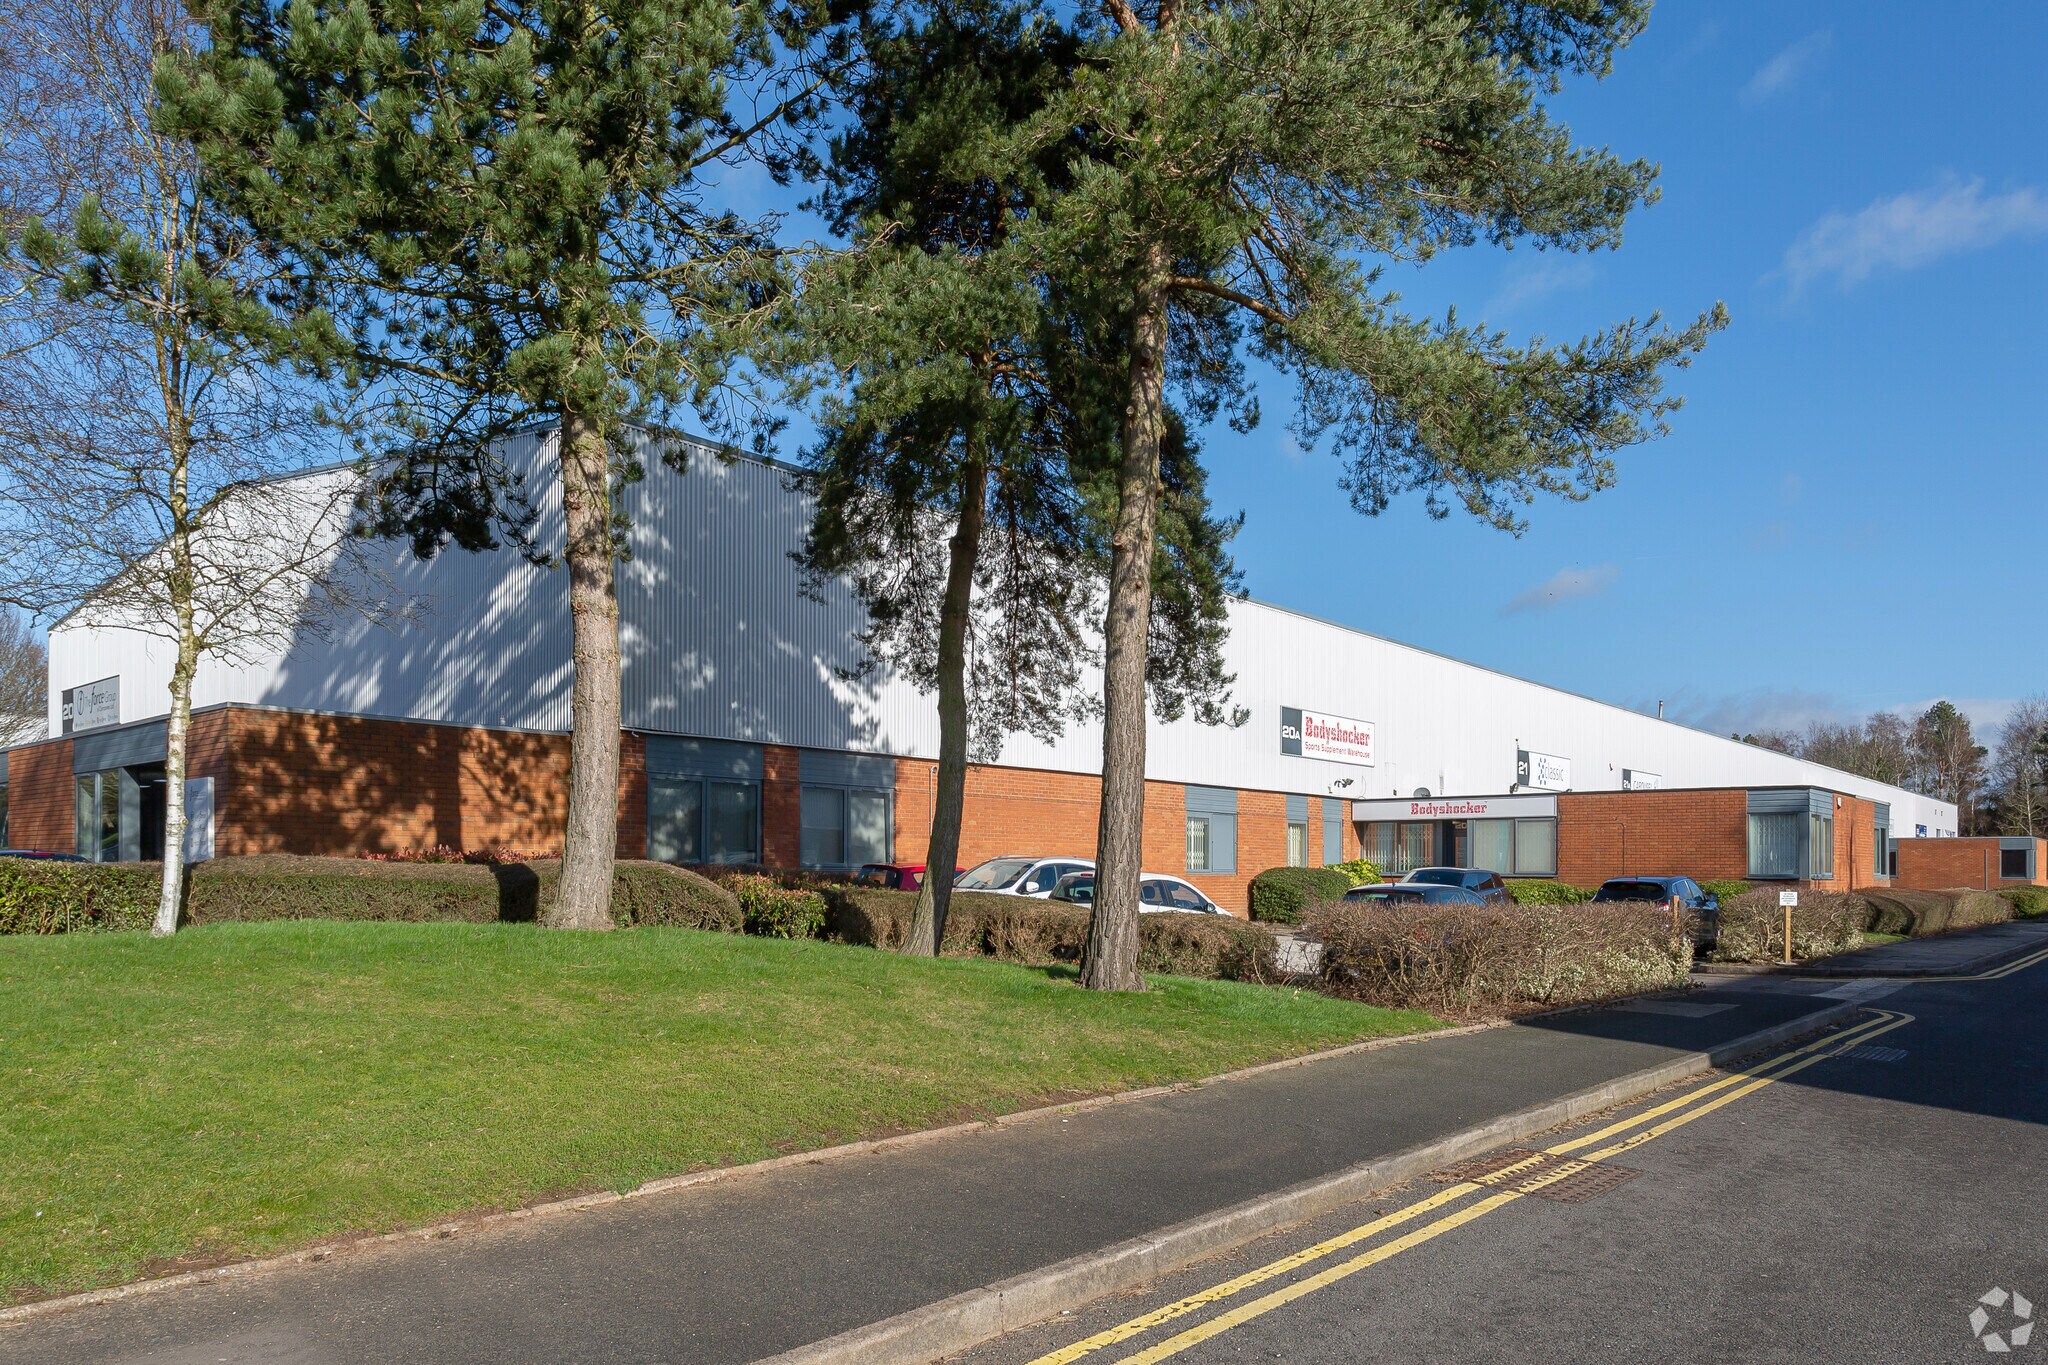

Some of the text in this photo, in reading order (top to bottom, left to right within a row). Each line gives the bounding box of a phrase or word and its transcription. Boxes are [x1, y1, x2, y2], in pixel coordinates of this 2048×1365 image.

[63, 702, 73, 720] 20
[1305, 716, 1370, 746] Bodyshocker
[1305, 741, 1370, 759] Sports Supplement Warehouse
[1518, 760, 1528, 775] 21
[1545, 761, 1564, 781] classic
[1411, 801, 1487, 817] Bodyshocker
